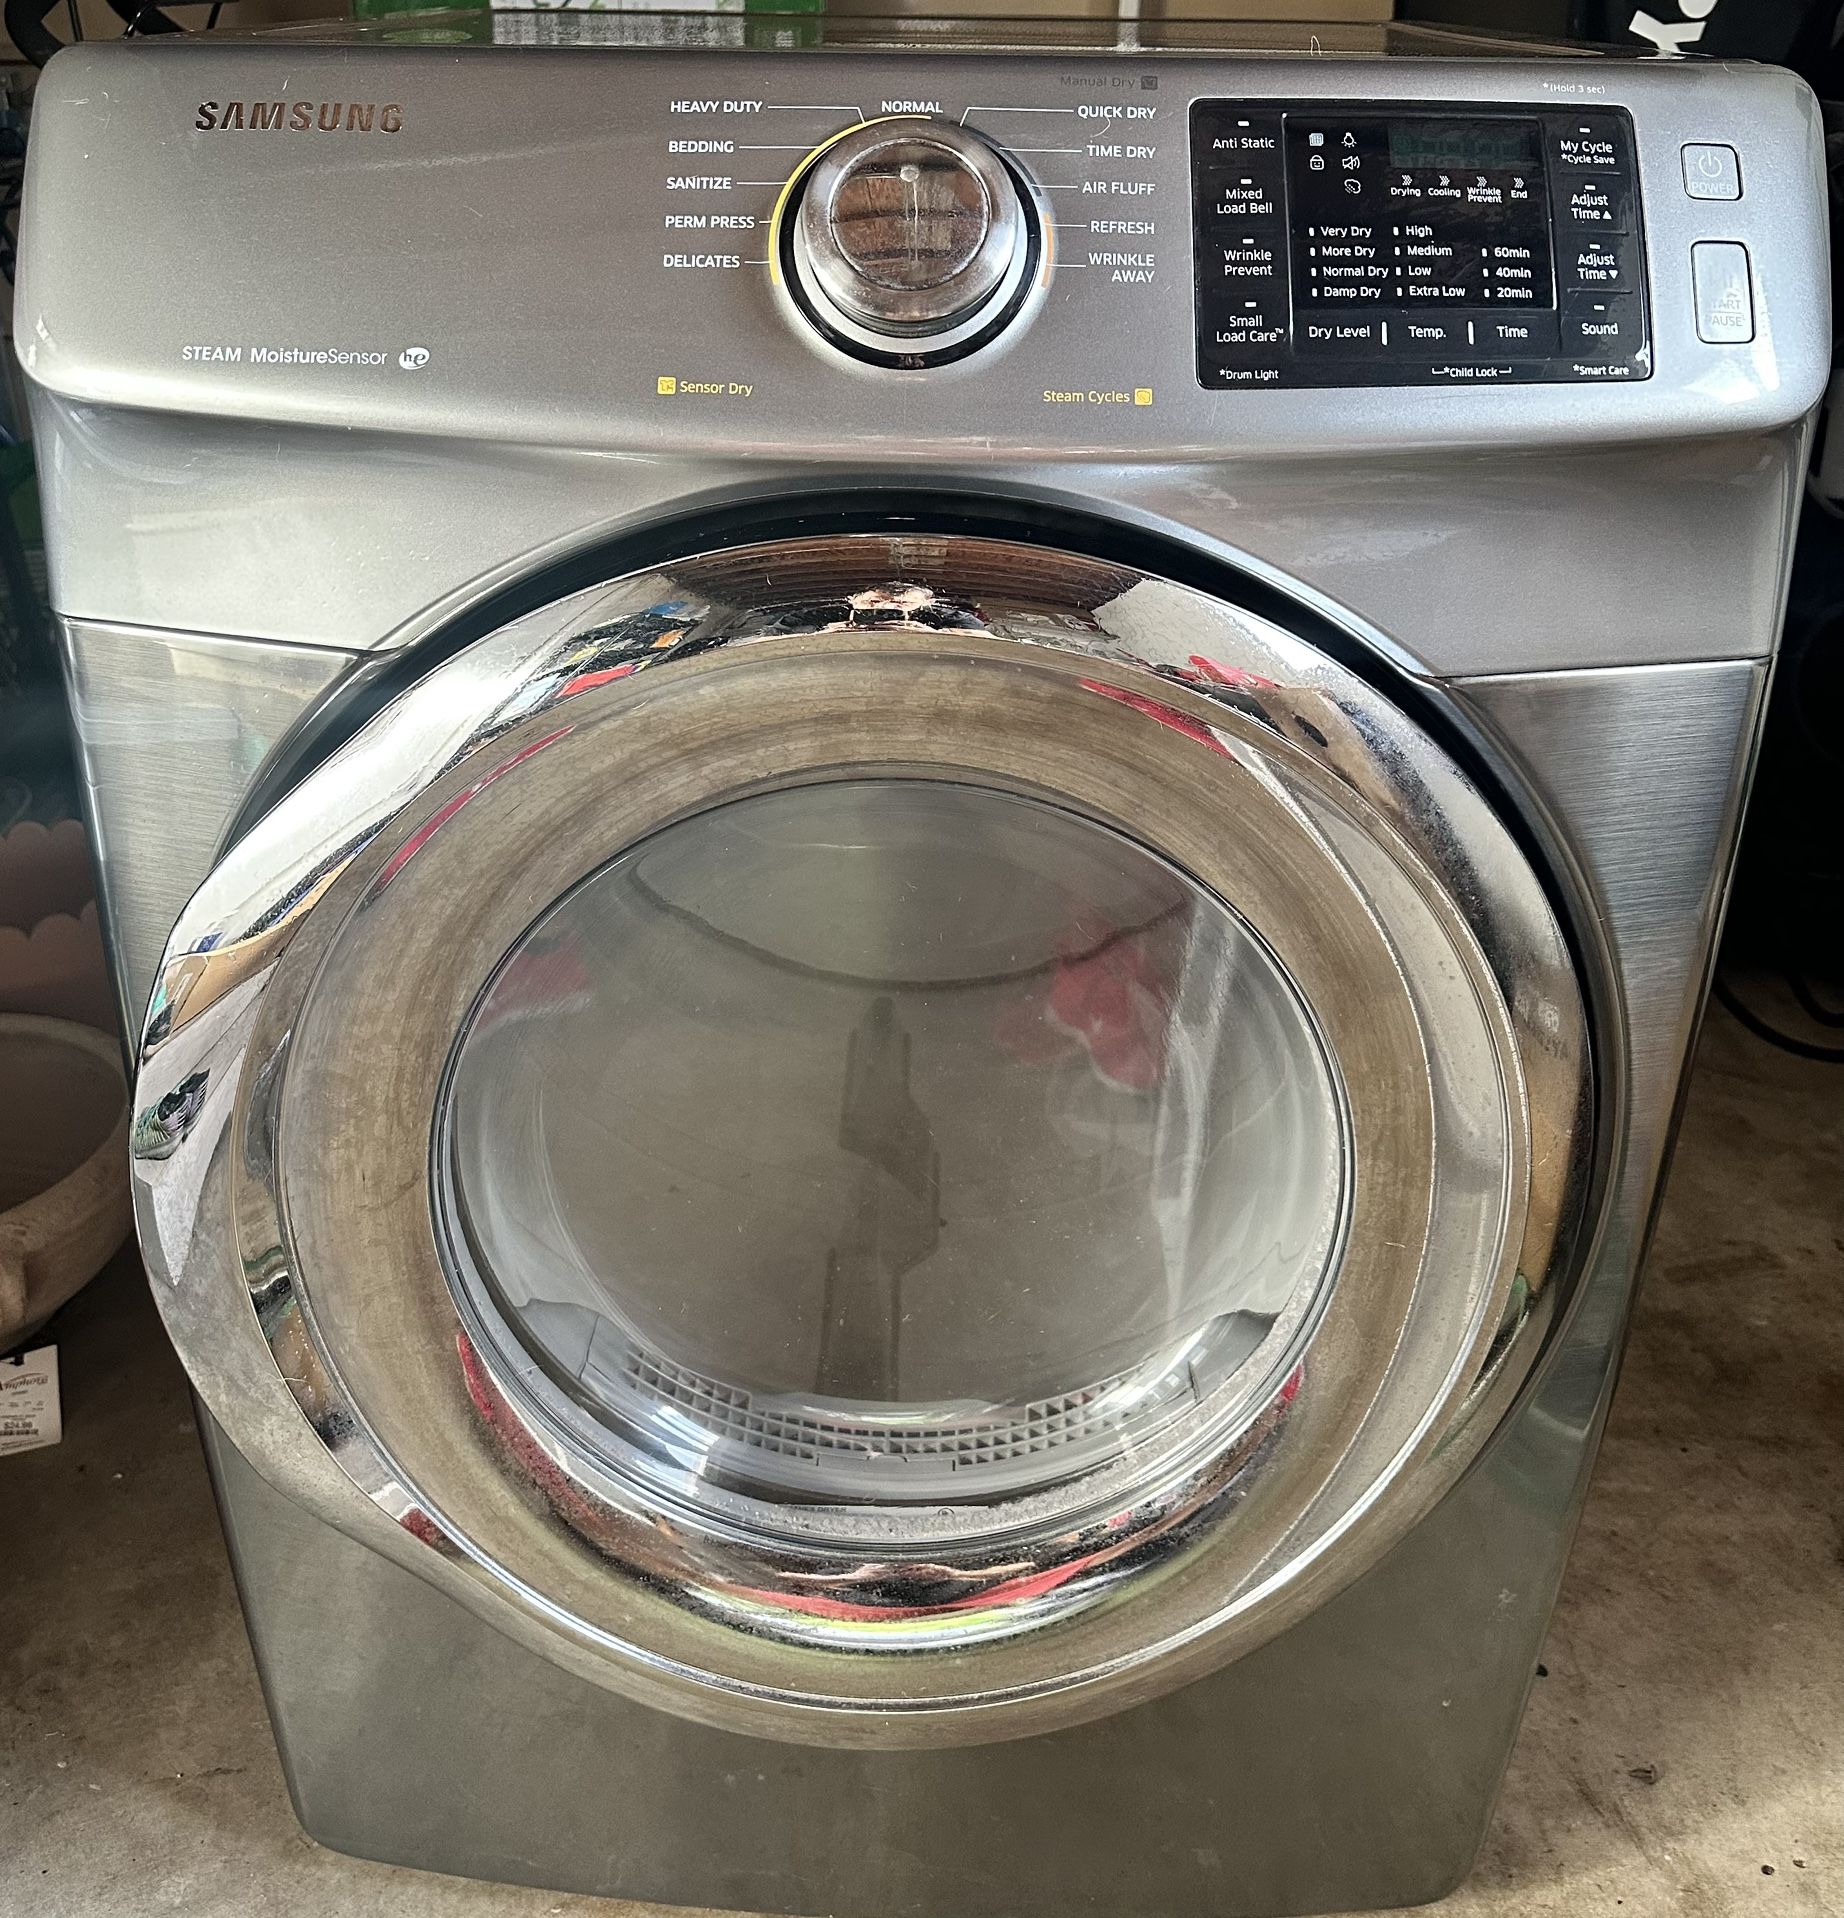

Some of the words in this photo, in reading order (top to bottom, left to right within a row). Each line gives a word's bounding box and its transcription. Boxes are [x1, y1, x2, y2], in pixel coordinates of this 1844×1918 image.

[1060, 76, 1107, 87] Manual
[1111, 77, 1135, 89] Dry
[1577, 85, 1584, 93] 3
[1586, 84, 1606, 94] sec)
[670, 101, 719, 113] HEAVY
[723, 101, 763, 113] DUTY
[881, 101, 943, 113] NORMAL
[1077, 105, 1123, 118] QUICK
[1126, 107, 1157, 119] DRY
[195, 101, 404, 133] SAMSUNG
[668, 140, 734, 153] BEDDING
[1212, 138, 1238, 149] Anti
[1241, 138, 1275, 149] Static
[1560, 140, 1578, 153] My
[1581, 140, 1613, 154] Cycle
[1086, 145, 1122, 157] TIME
[1126, 146, 1156, 159] DRY
[1593, 155, 1615, 164] Save
[666, 176, 732, 190] SANITIZE
[1082, 182, 1107, 194] AIR
[1111, 182, 1156, 195] FLUFF
[1690, 182, 1734, 194] POWER
[1225, 188, 1263, 200] Mixed
[1390, 187, 1421, 197] Drying
[1428, 188, 1461, 198] Cooling
[1467, 187, 1502, 195] Wrinkle
[1510, 190, 1527, 198] End
[1467, 194, 1502, 203] Prevent
[1571, 193, 1608, 206] Adjust
[1216, 203, 1246, 214] Load
[1249, 203, 1273, 214] Bell
[1571, 207, 1601, 220] Time
[665, 215, 706, 228] PERM
[710, 215, 755, 228] PRESS
[1090, 221, 1155, 234] REFRESH
[1320, 226, 1347, 238] Very
[1350, 226, 1372, 238] Dry
[1405, 225, 1433, 238] High
[1223, 249, 1272, 261] Wrinkle
[1322, 246, 1352, 256] More
[1354, 246, 1376, 258] Dry
[1407, 245, 1453, 256] Medium
[1494, 247, 1531, 258] 60min
[663, 254, 740, 267] DELICATES
[1088, 253, 1155, 267] WRINKLE
[1577, 253, 1615, 267] Adjust
[1111, 270, 1155, 283] AWAY
[1224, 265, 1273, 276] Prevent
[1322, 266, 1365, 276] Normal
[1367, 266, 1389, 278] Dry
[1408, 265, 1432, 276] Low
[1495, 267, 1532, 279] 40min
[1577, 268, 1607, 280] Time
[1323, 286, 1357, 298] Damp
[1359, 286, 1381, 298] Dry
[1409, 286, 1440, 297] Extra
[1442, 286, 1466, 297] Low
[1496, 287, 1533, 299] 20min
[1229, 315, 1263, 327] Small
[1308, 325, 1333, 340] Dry
[1336, 325, 1371, 338] Level
[1408, 325, 1447, 340] Temp.
[1496, 325, 1528, 338] Time
[1581, 322, 1619, 335] Sound
[1216, 330, 1246, 343] Load
[181, 346, 242, 362] STEAM
[250, 348, 388, 365] MoistureSensor
[1254, 369, 1279, 380] Light
[1475, 367, 1498, 377] Lock
[1608, 365, 1629, 376] Care
[679, 380, 725, 394] Sensor
[728, 381, 753, 396] Dry
[1043, 389, 1085, 403] Steam
[1088, 390, 1130, 405] Cycles
